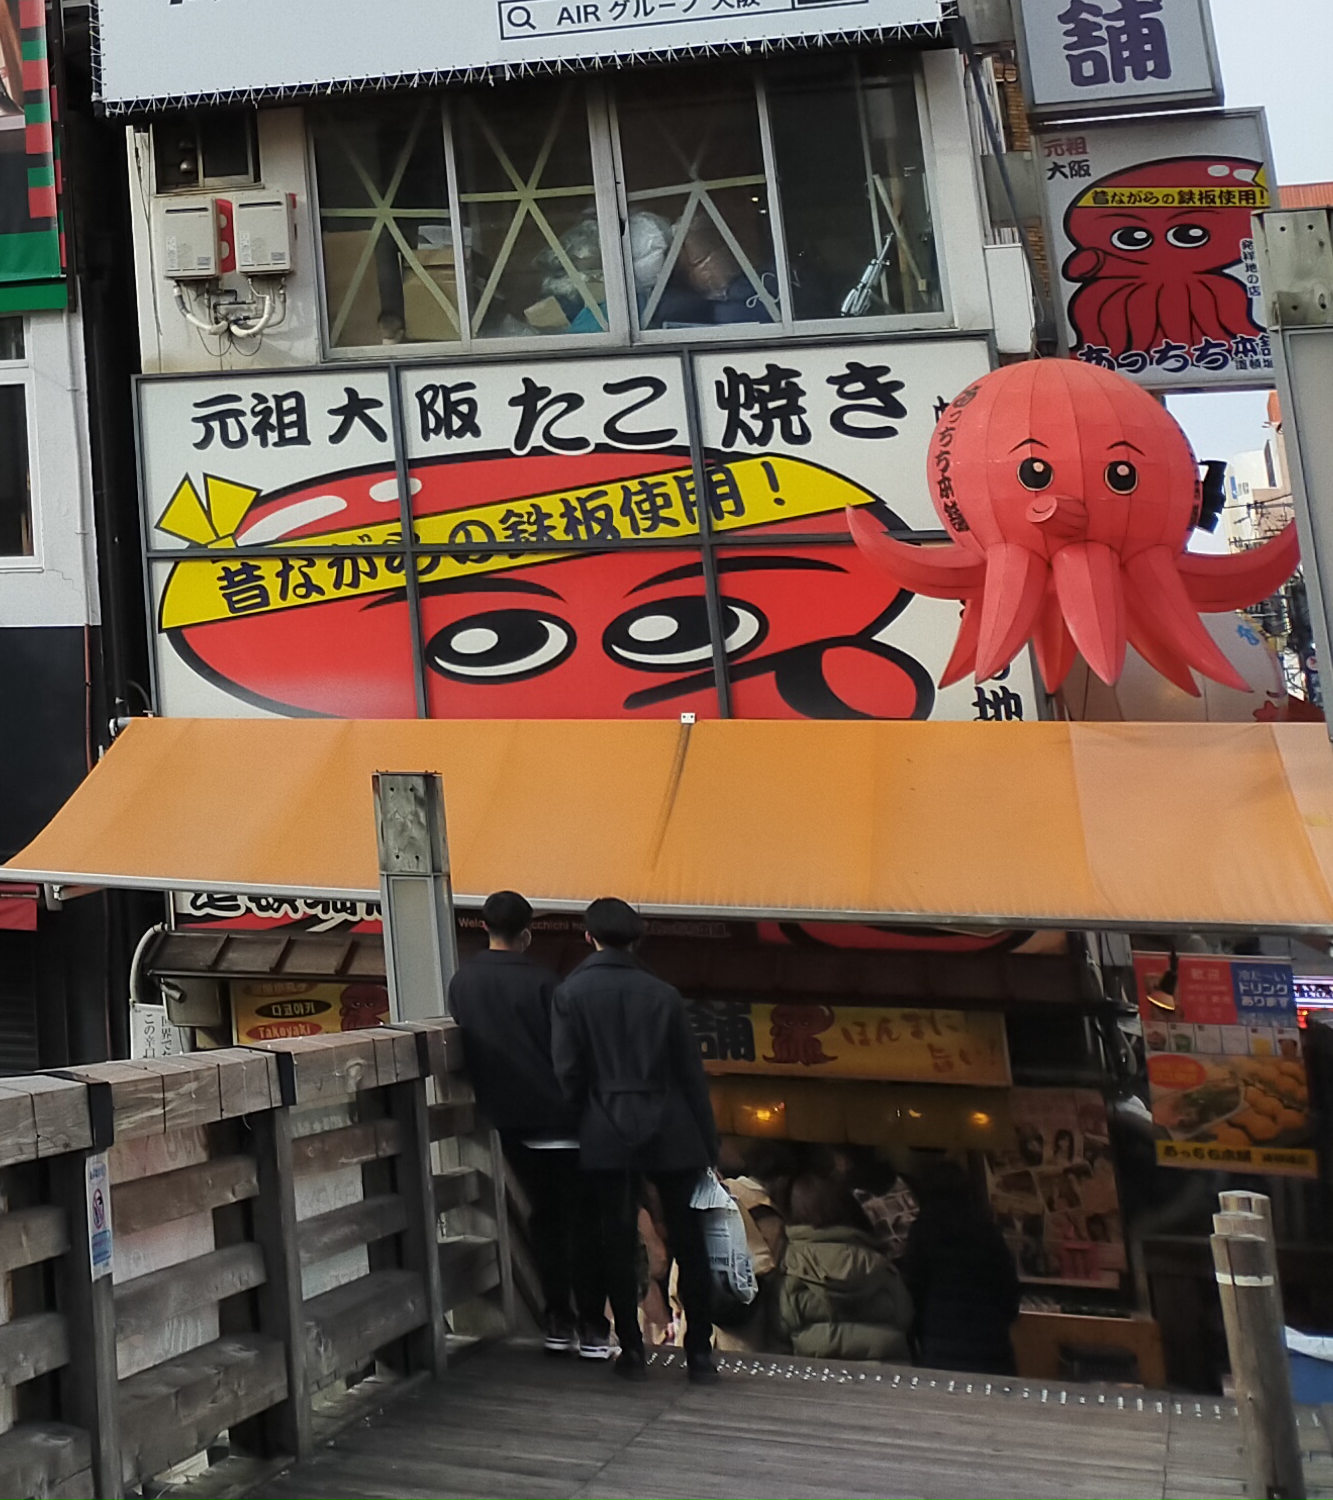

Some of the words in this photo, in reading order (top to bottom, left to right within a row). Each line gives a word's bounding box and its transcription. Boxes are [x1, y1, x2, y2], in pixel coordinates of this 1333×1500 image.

[1043, 136, 1090, 158] 元祖
[1046, 158, 1092, 181] 大阪
[1238, 982, 1289, 996] ドリンク
